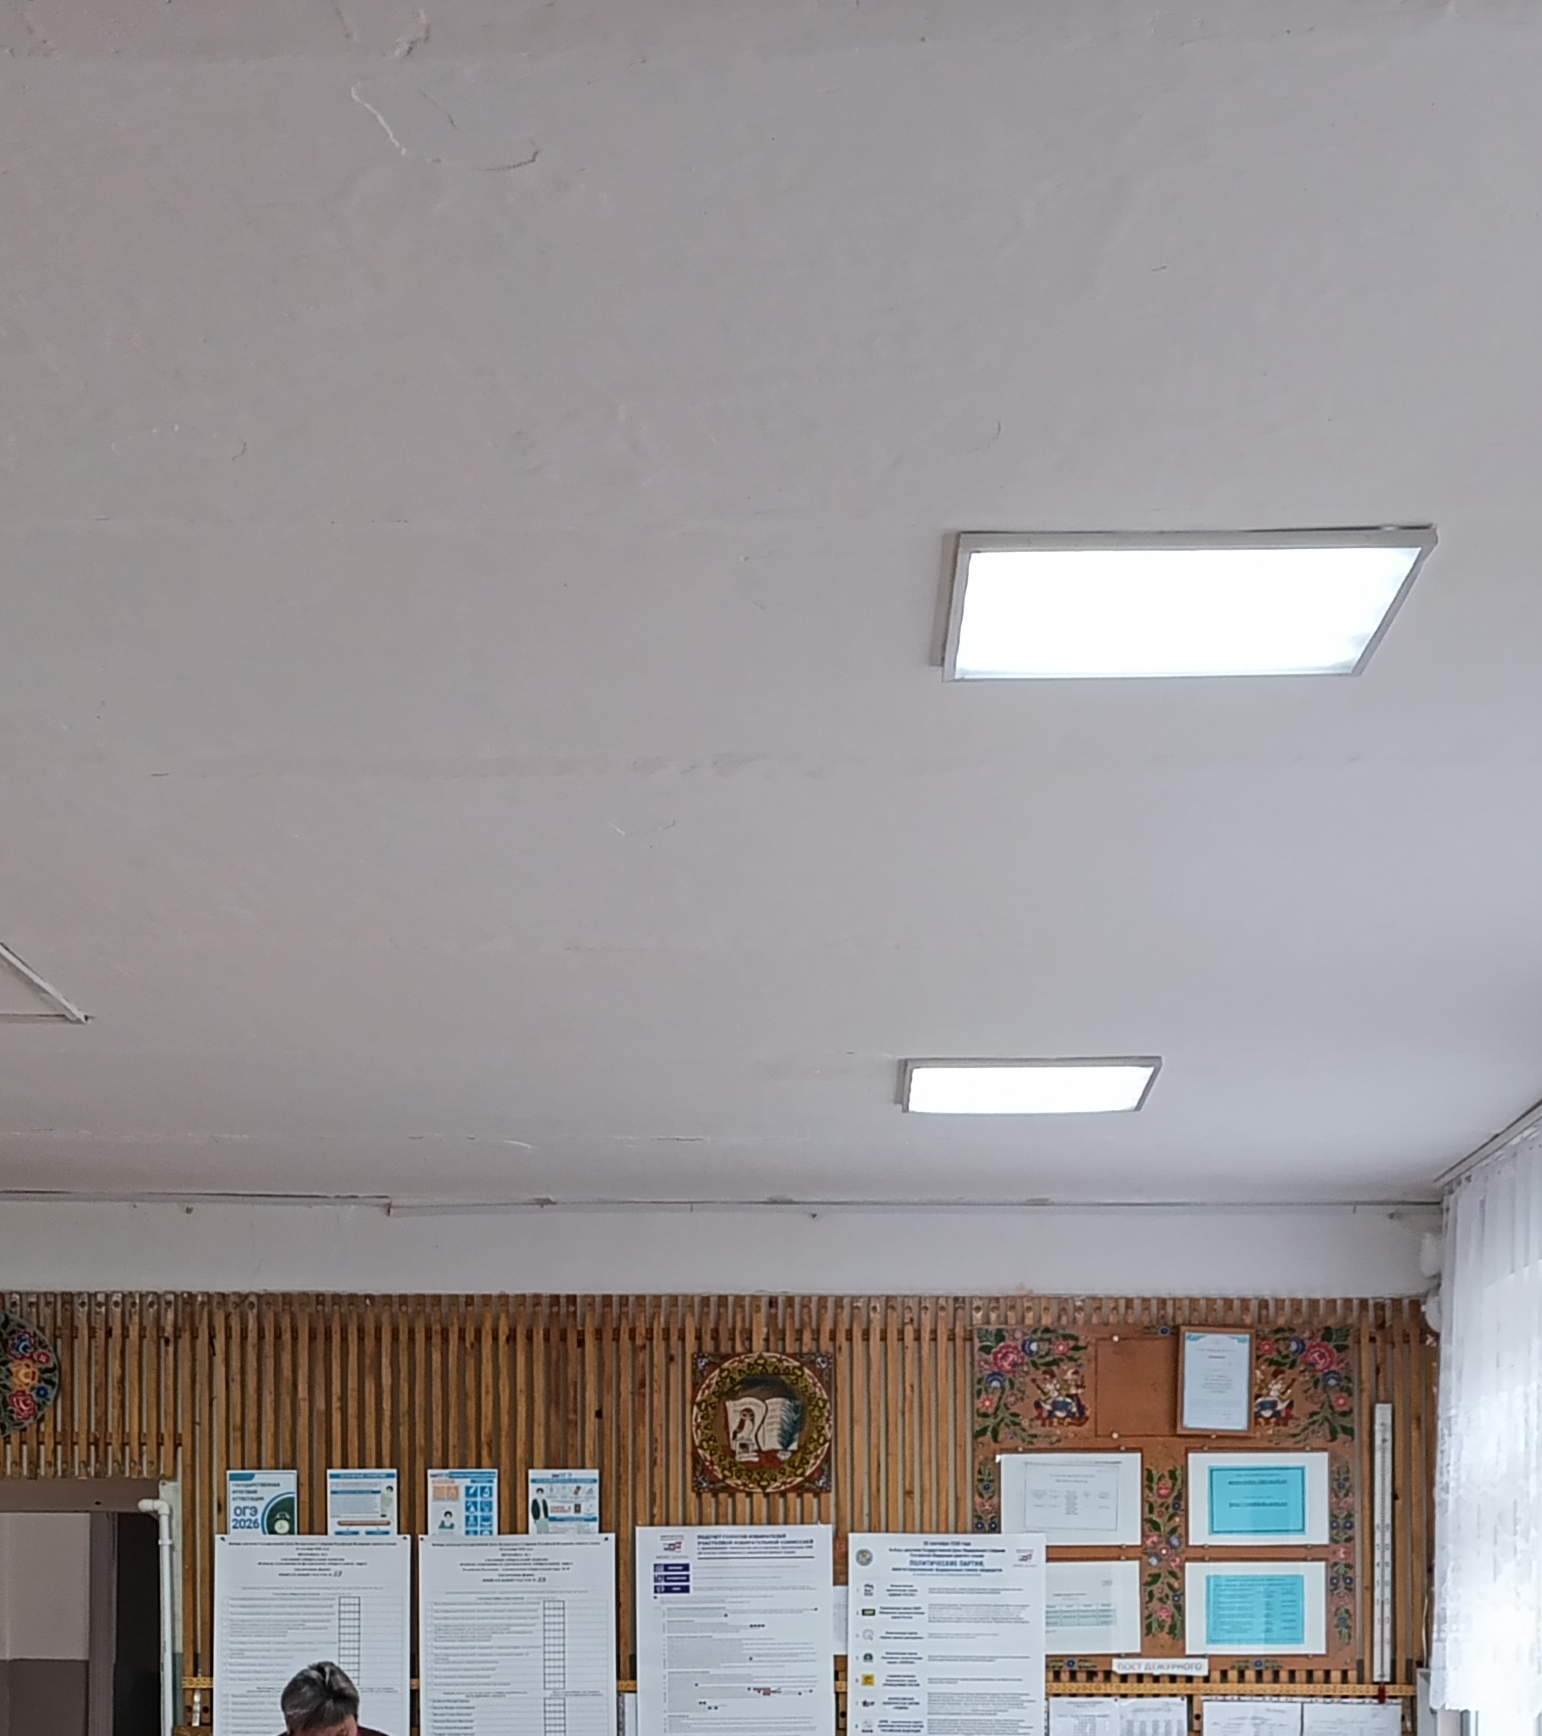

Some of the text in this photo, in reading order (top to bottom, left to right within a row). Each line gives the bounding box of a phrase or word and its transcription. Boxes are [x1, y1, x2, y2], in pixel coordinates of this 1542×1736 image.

[233, 1505, 258, 1517] ОГЭ
[231, 1518, 260, 1530] 2026
[1117, 1662, 1203, 1672] ПОСТ ДЕЖУРНОГО
